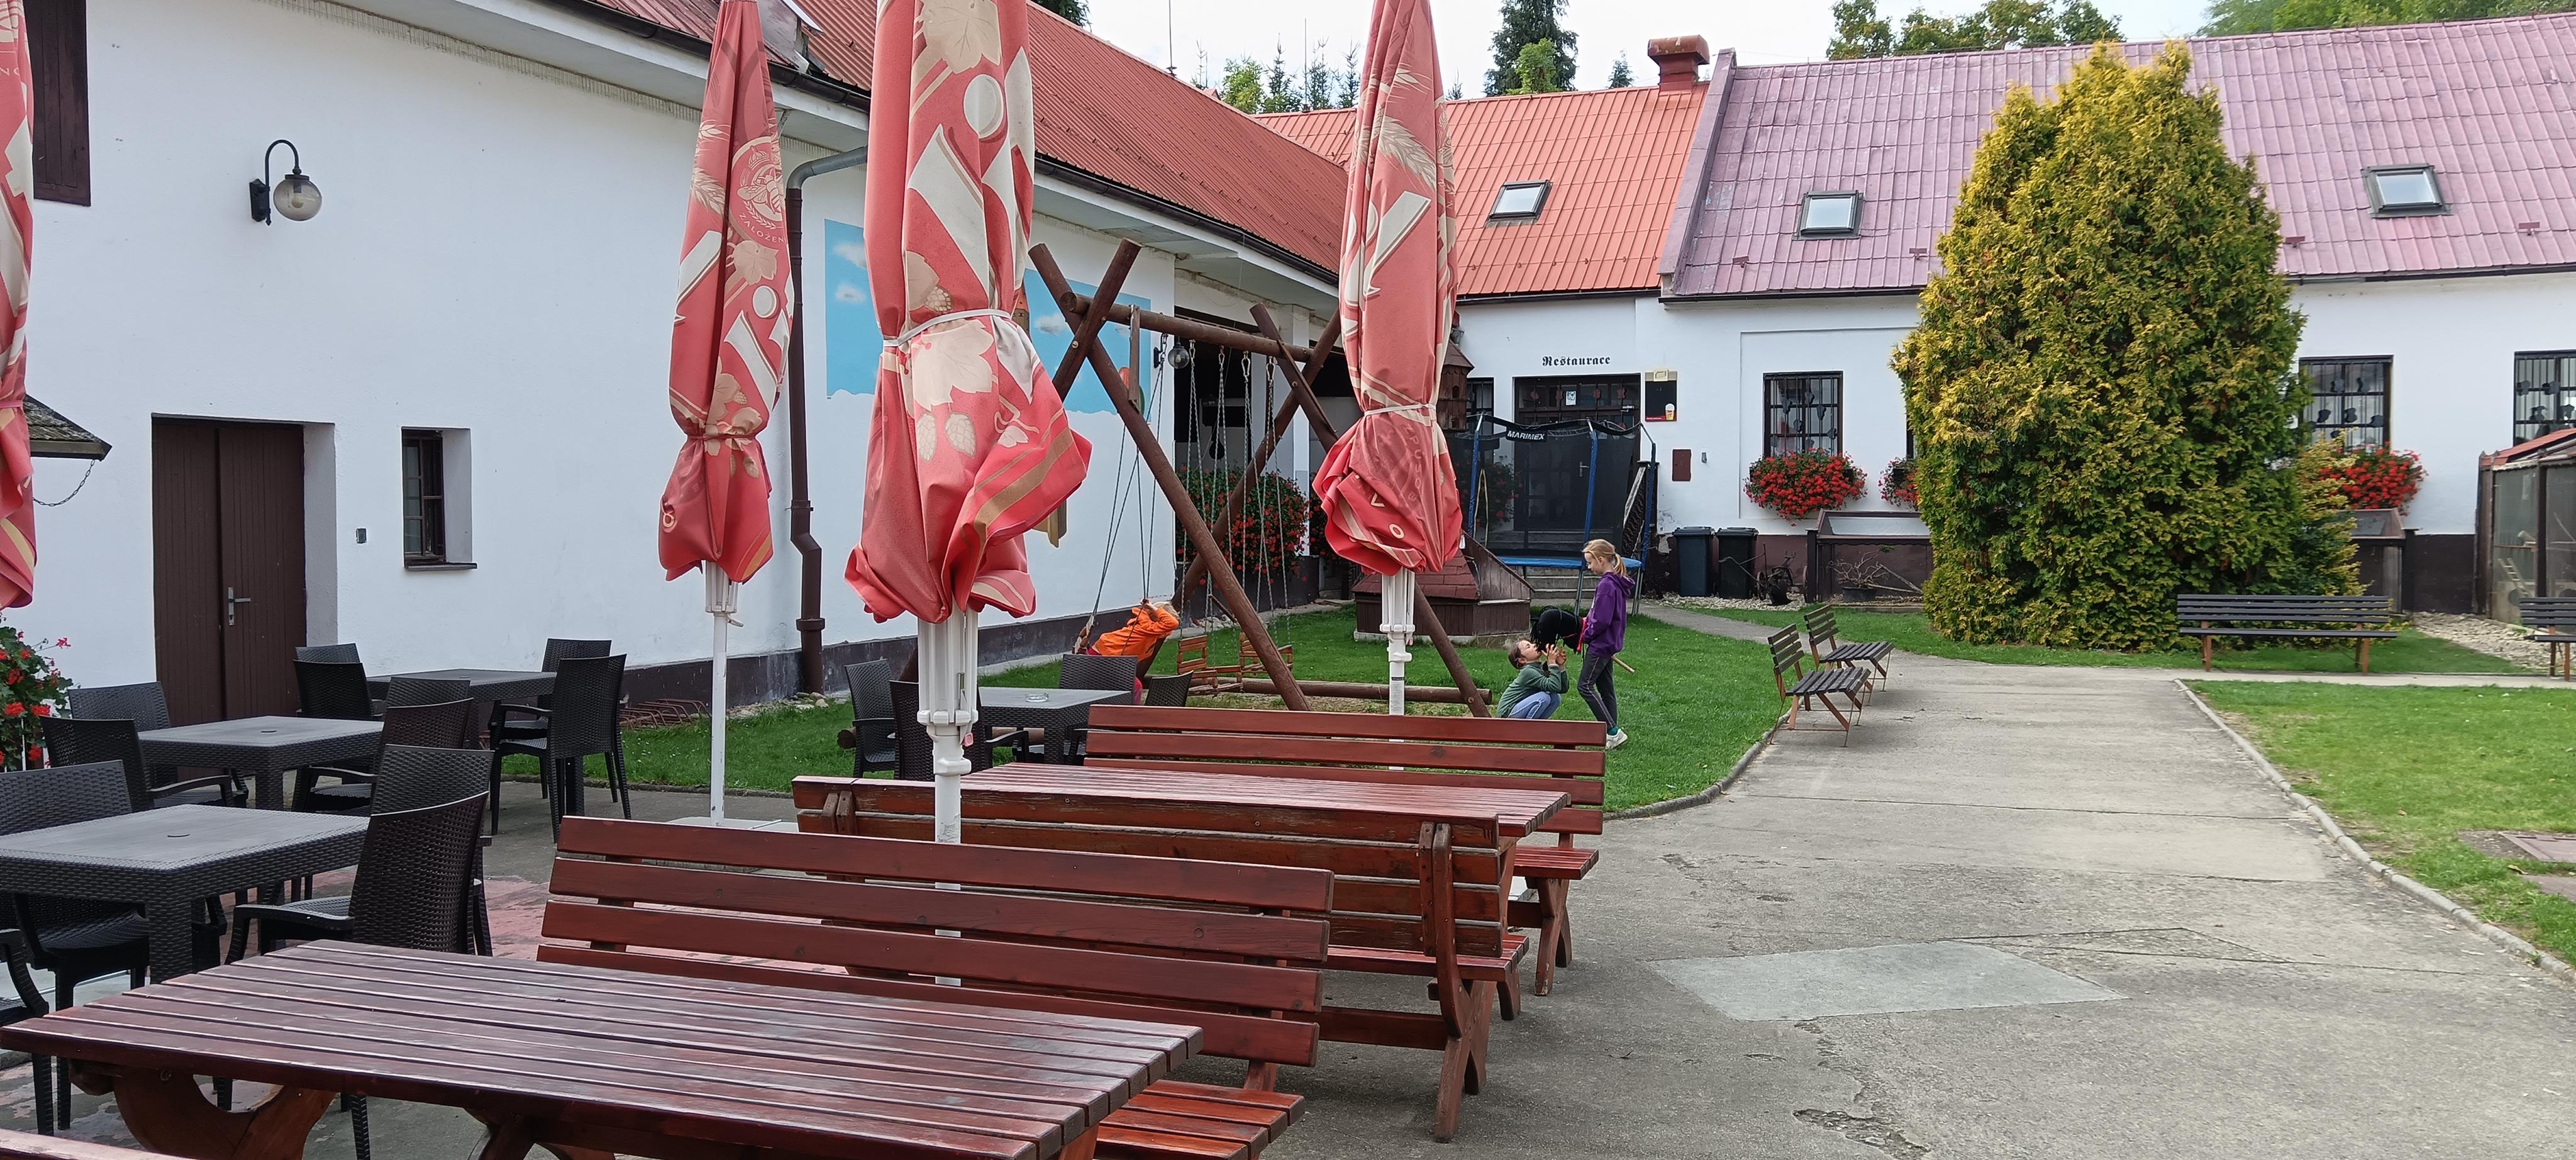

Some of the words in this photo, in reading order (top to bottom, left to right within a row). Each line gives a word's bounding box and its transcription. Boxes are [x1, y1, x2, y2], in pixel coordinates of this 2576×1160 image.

[739, 213, 786, 243] ZALOŽEN
[1541, 355, 1611, 367] Restaurace
[1506, 430, 1545, 440] MARIMEX
